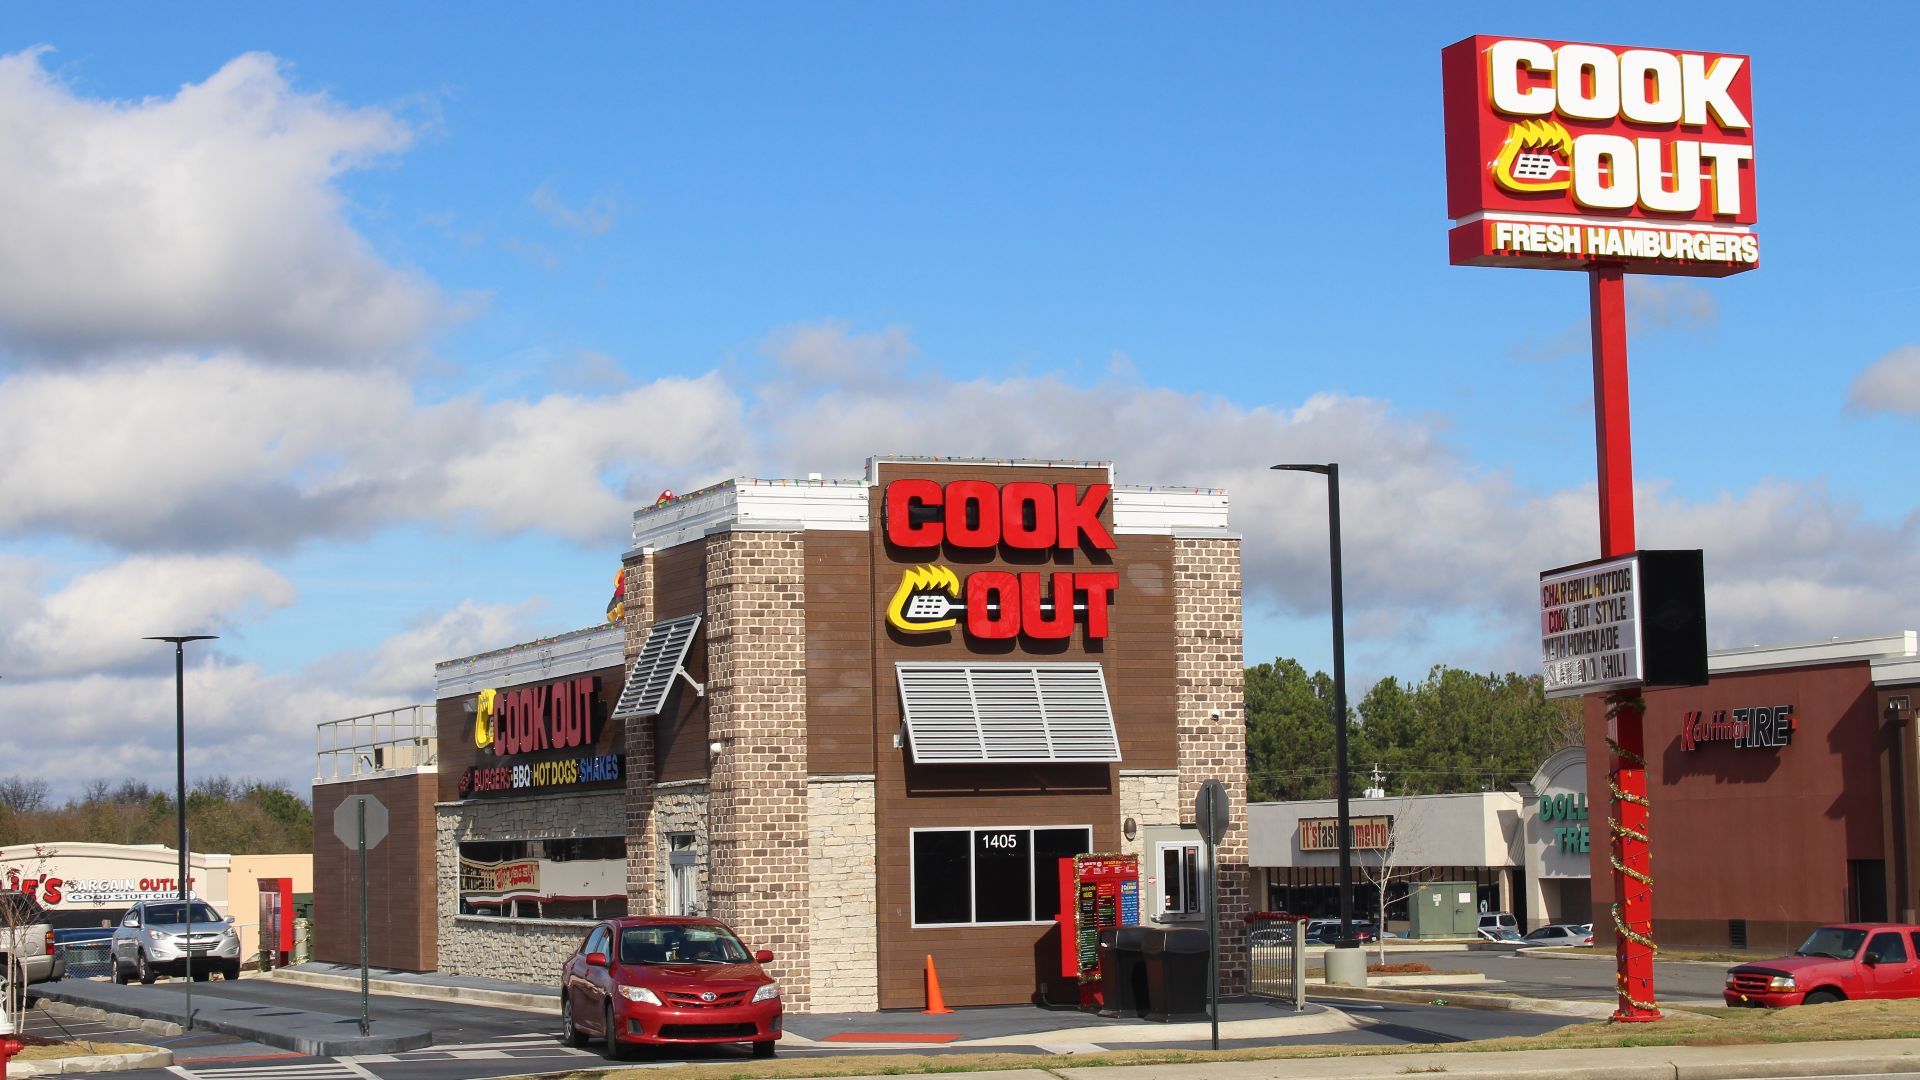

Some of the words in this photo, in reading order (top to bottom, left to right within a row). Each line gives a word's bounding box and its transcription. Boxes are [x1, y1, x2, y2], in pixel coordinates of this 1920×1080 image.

[1489, 40, 1751, 129] COOK
[1573, 134, 1753, 215] OUT
[1494, 221, 1582, 256] FRESH
[1588, 227, 1759, 263] HAMBURGERS
[887, 479, 1118, 549] COOK
[967, 571, 1120, 639] OUT
[1544, 581, 1566, 608] CHAR
[1568, 576, 1593, 602] GRILL
[1549, 607, 1570, 633] COOK
[1596, 597, 1627, 624] STYLE
[1568, 626, 1620, 656] HOMEMADE
[1601, 653, 1627, 679] CHILI
[494, 685, 549, 757] COOK
[552, 677, 594, 749] OUT
[1681, 711, 1751, 751] Kauffman
[1733, 705, 1790, 748] TIRE
[473, 767, 511, 792] BURGERS
[513, 764, 531, 789] BBQ
[533, 761, 550, 786] HOT
[552, 758, 577, 785] DOGS
[580, 754, 619, 782] SHAKES
[982, 834, 1017, 849] 1405
[114, 892, 151, 900] STUFF
[139, 878, 196, 892] OUTLT
